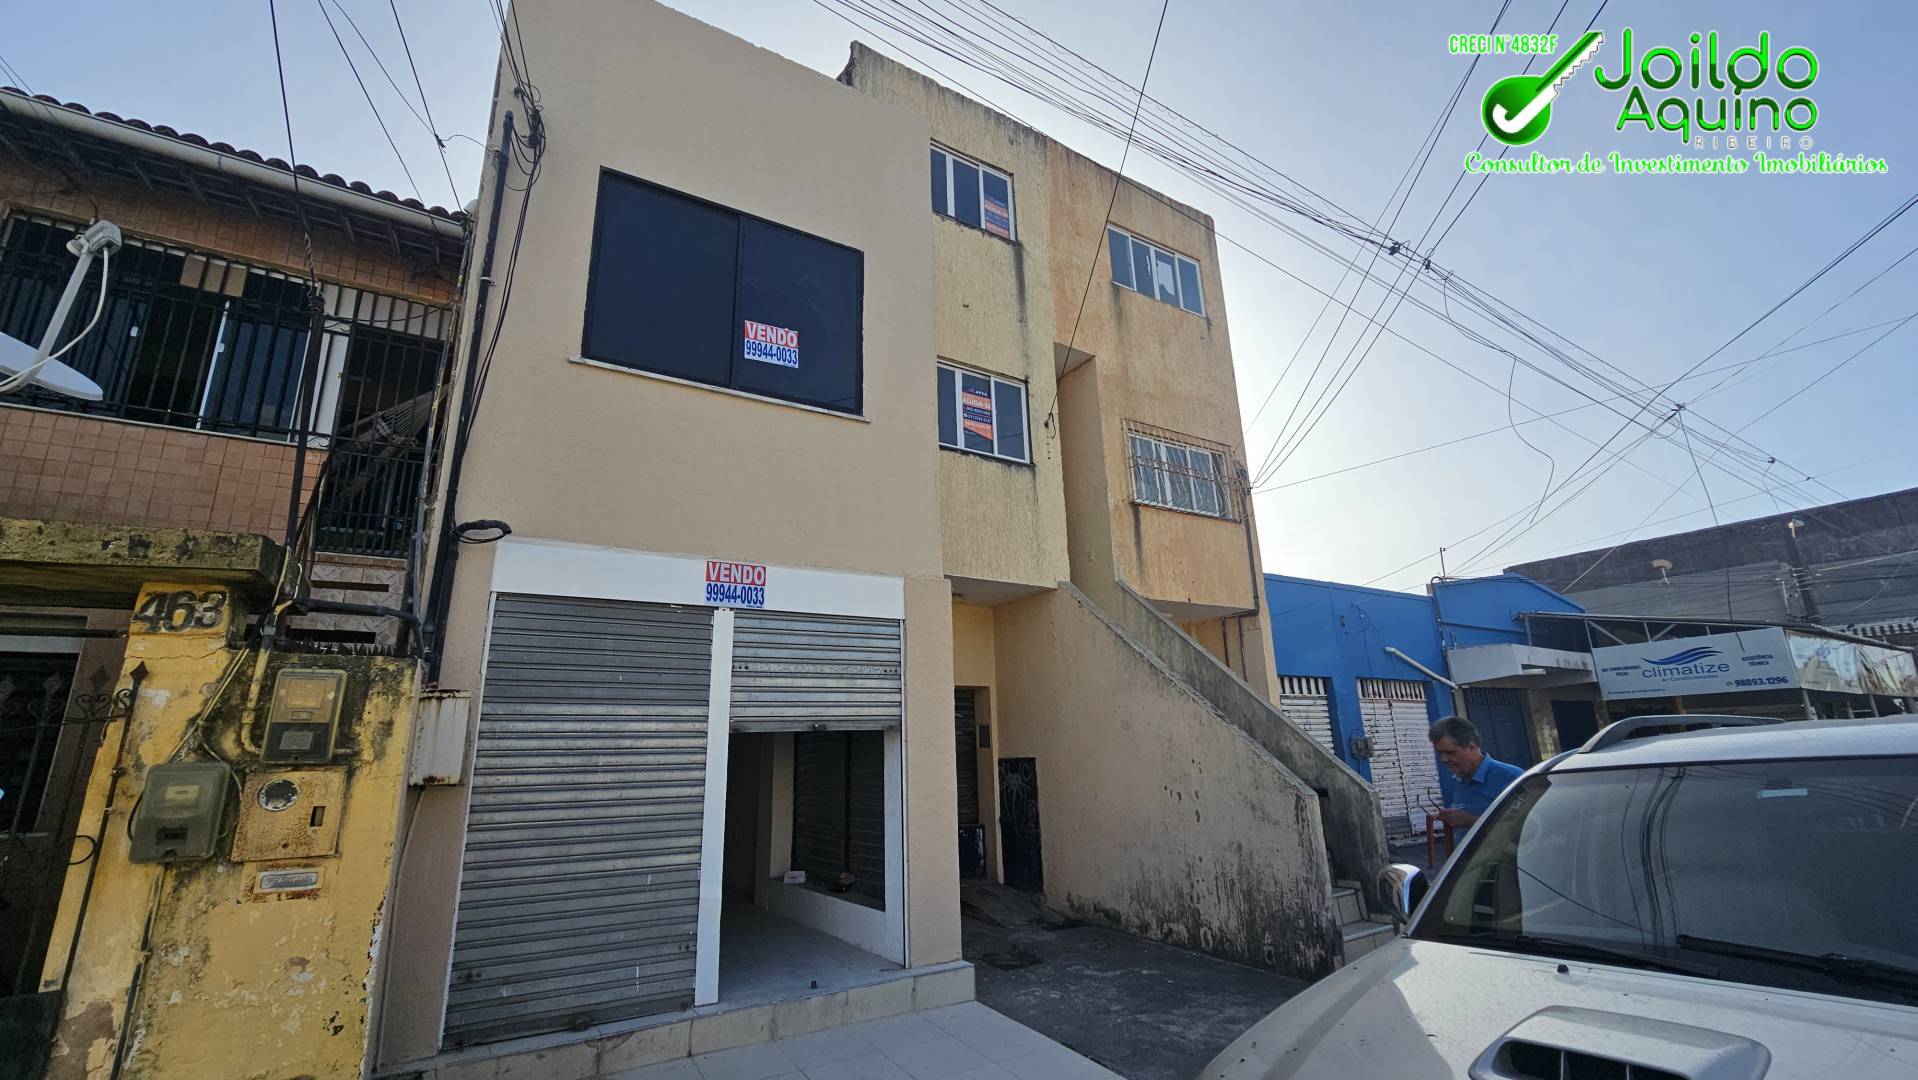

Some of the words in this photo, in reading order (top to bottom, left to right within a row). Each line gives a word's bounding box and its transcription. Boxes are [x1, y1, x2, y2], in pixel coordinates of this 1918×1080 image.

[746, 321, 797, 348] VENDO
[746, 340, 797, 365] 99944-0033
[708, 562, 765, 585] VENDO
[706, 583, 765, 605] 99944-0033
[131, 590, 227, 631] 463
[1642, 662, 1730, 678] climatize
[1734, 675, 1788, 687] 98893.1296
